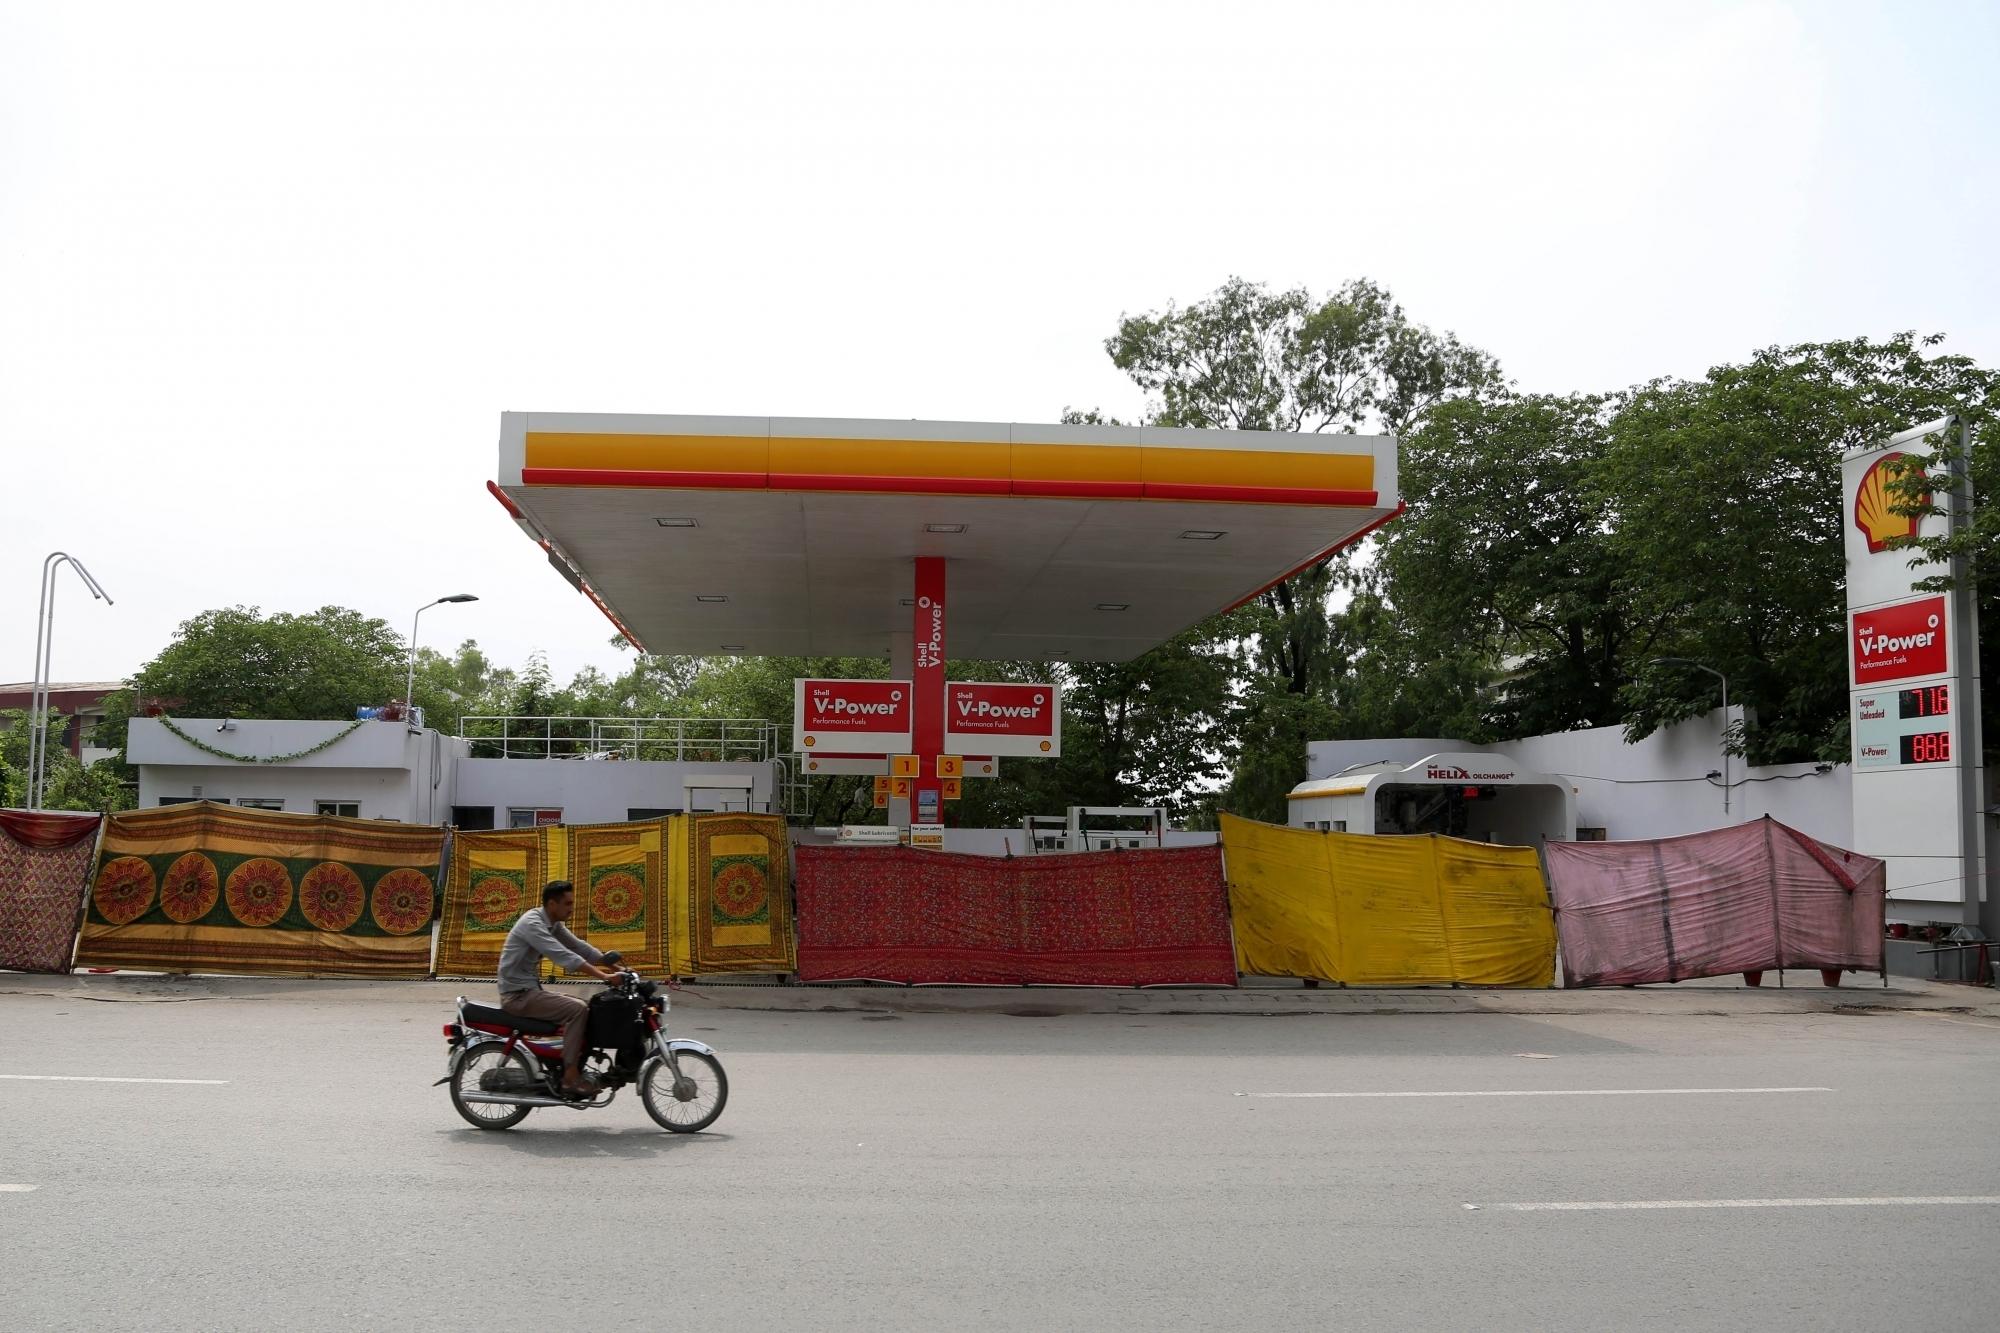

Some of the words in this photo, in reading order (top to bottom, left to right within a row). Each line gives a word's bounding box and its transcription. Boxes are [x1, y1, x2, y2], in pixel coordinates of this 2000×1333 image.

[928, 602, 942, 668] V-Power
[1859, 626, 1873, 636] Shell
[1859, 631, 1936, 656] V-Power
[917, 642, 928, 668] Shell
[1860, 659, 1893, 670] Performance
[1893, 654, 1907, 664] Fuels
[813, 697, 898, 715] V-Power
[957, 700, 1041, 718] V-Power
[1859, 698, 1875, 709] Super
[1860, 709, 1885, 720] Unleaded
[812, 717, 850, 725] Performance
[956, 719, 994, 728] Performance
[1861, 747, 1888, 757] V-Power
[903, 760, 911, 772] 1
[944, 760, 955, 773] 3
[1427, 768, 1471, 780] HELIX
[880, 779, 889, 789] 5
[897, 782, 908, 794] 2
[946, 782, 956, 794] 4
[877, 795, 885, 805] 6
